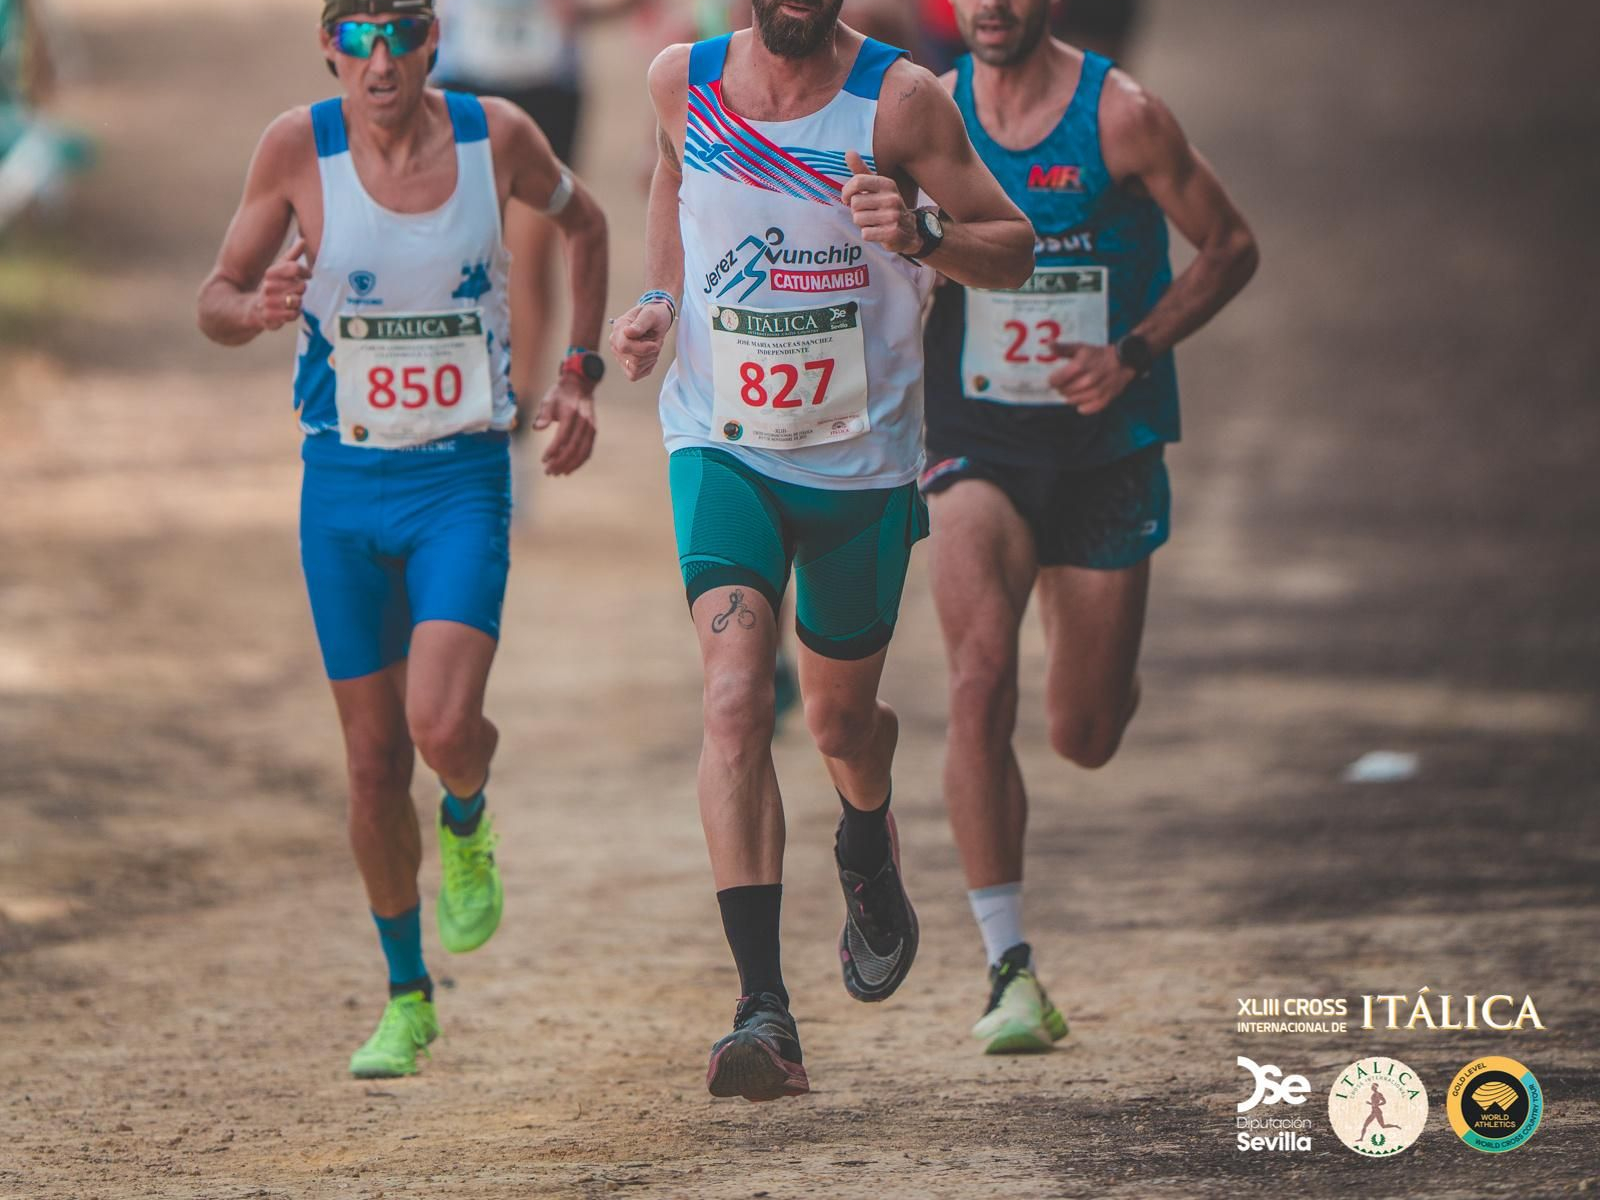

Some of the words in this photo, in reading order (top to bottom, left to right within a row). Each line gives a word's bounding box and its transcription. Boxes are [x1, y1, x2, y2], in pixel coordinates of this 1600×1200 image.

[703, 249, 739, 294] Jerez
[747, 314, 818, 333] ITÁLICA
[1003, 319, 1063, 364] 23
[367, 363, 463, 410] 850
[738, 358, 836, 409] 827
